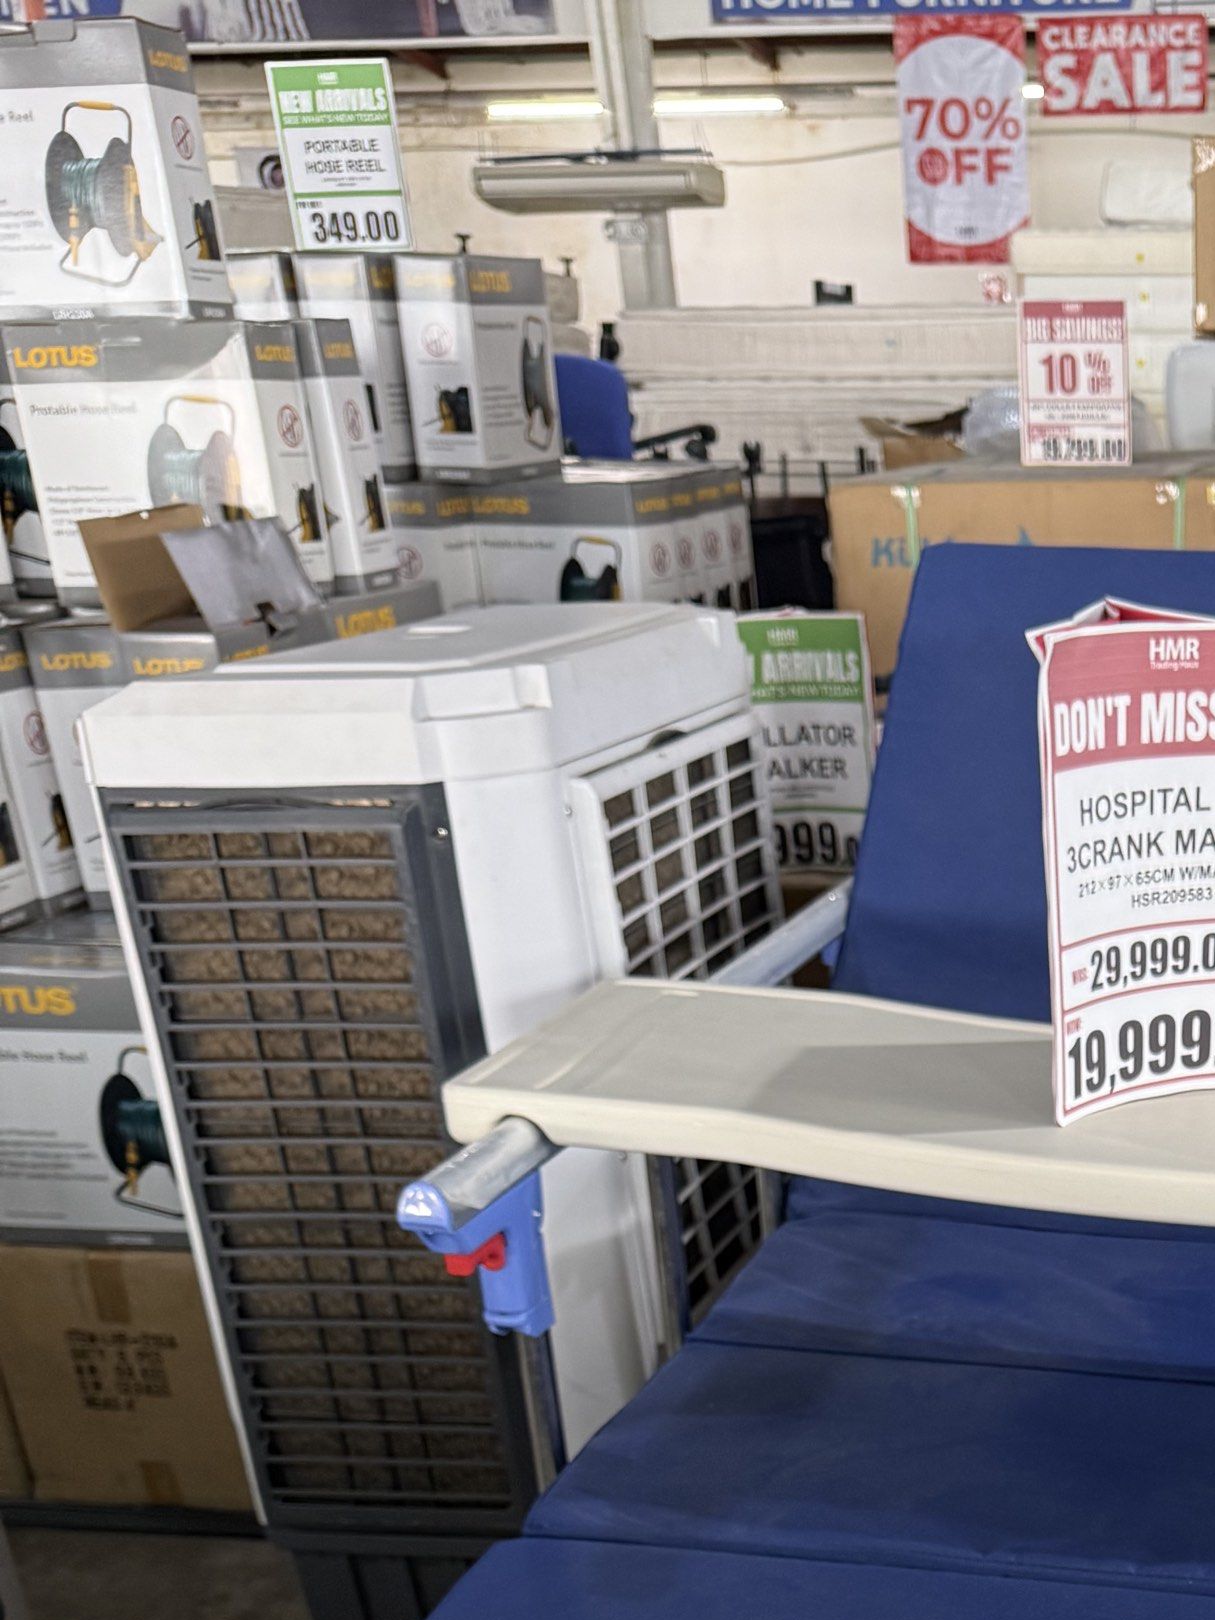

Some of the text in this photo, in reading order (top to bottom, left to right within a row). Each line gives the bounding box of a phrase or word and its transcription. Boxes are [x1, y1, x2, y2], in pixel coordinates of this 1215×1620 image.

[1042, 23, 1202, 50] CLEARANCE
[1043, 50, 1205, 111] SALE
[905, 96, 1022, 142] 70%
[304, 138, 381, 154] PORTABLE
[305, 159, 387, 174] HOSE REEL
[917, 147, 1014, 187] OFF
[312, 211, 400, 243] 349.00
[13, 345, 98, 369] LOTUS
[1039, 353, 1077, 395] 10
[40, 653, 113, 672] LOTUS
[1149, 637, 1200, 661] HMR
[762, 651, 860, 685] ARRIVALS
[762, 722, 856, 747] LLATOR
[1053, 694, 1131, 757] DON'T
[767, 757, 848, 782] ALKER
[1079, 786, 1211, 827] HOSPITAL
[1067, 831, 1165, 874] 3CRANK
[1131, 886, 1214, 909] HSR209583
[0, 983, 76, 1016] TUS
